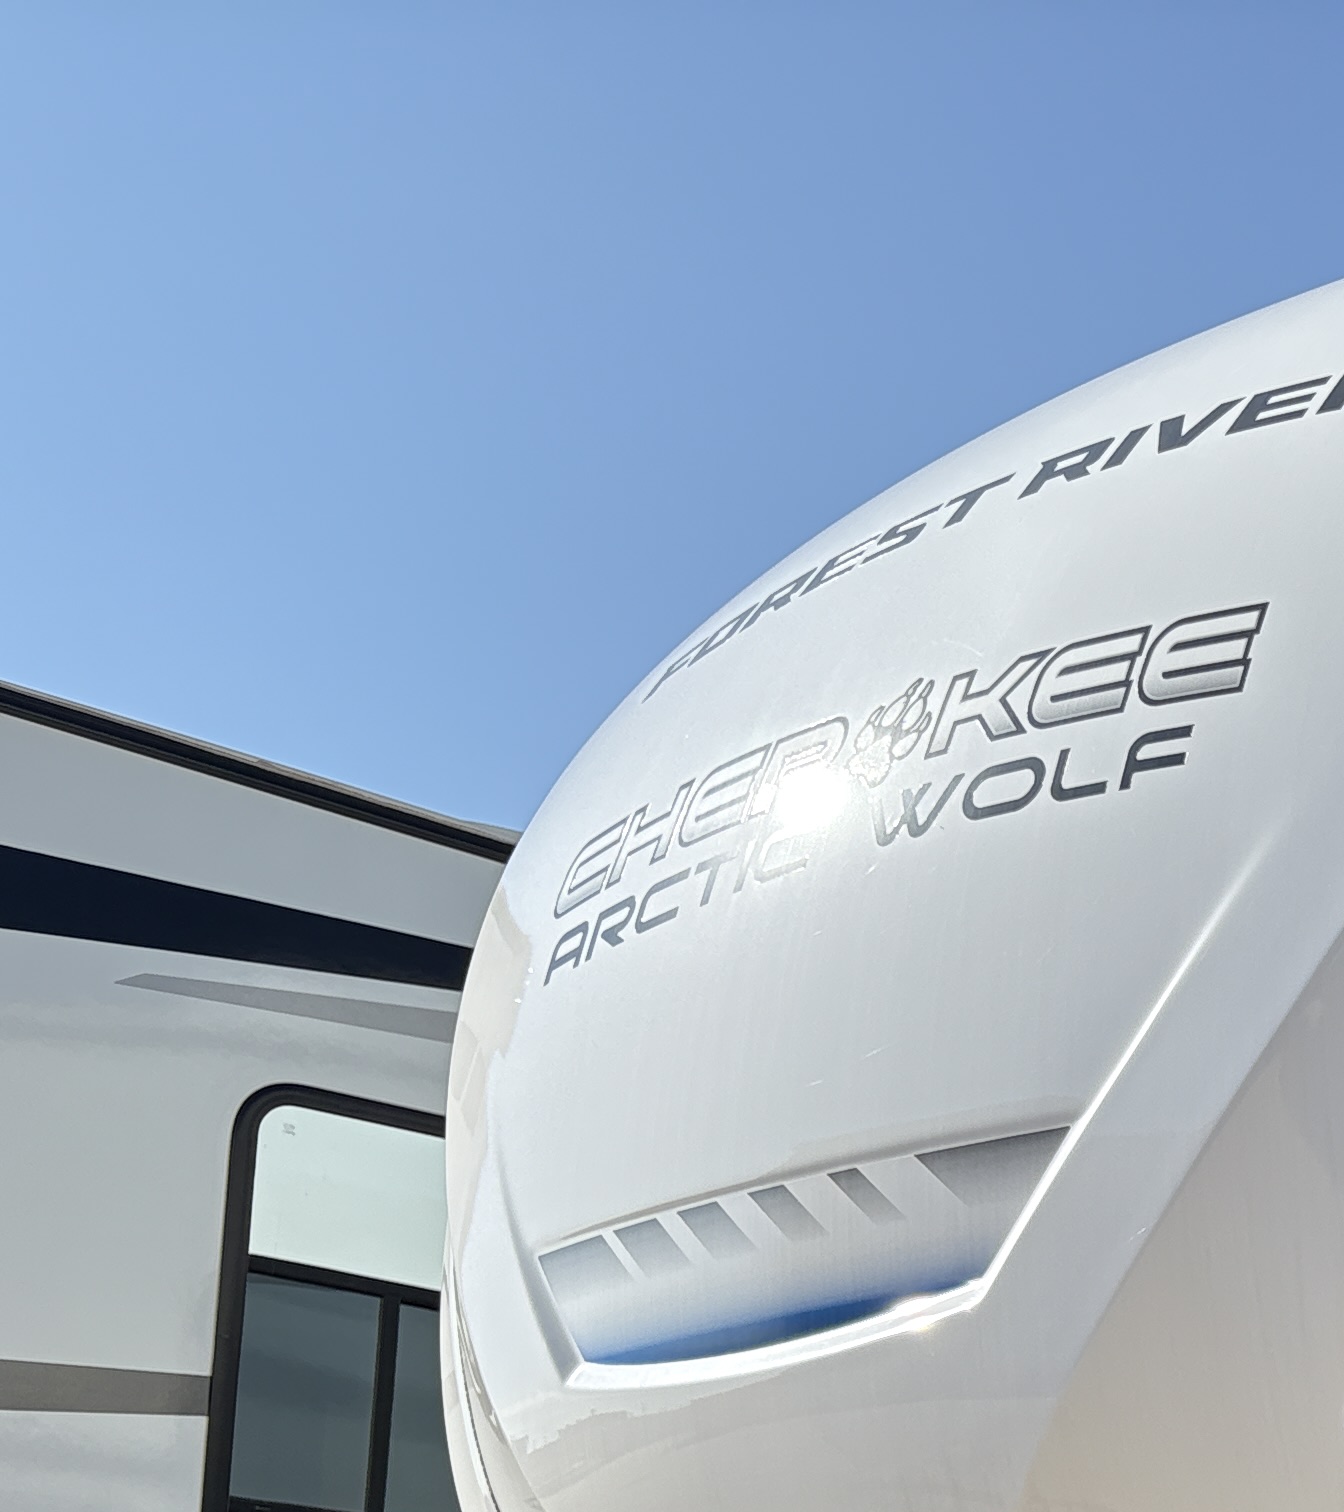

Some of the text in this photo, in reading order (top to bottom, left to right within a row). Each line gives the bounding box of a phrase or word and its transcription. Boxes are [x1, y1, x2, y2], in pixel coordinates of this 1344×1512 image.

[643, 473, 1016, 703] FOREST
[543, 723, 1196, 987] ARCTIC WOLF
